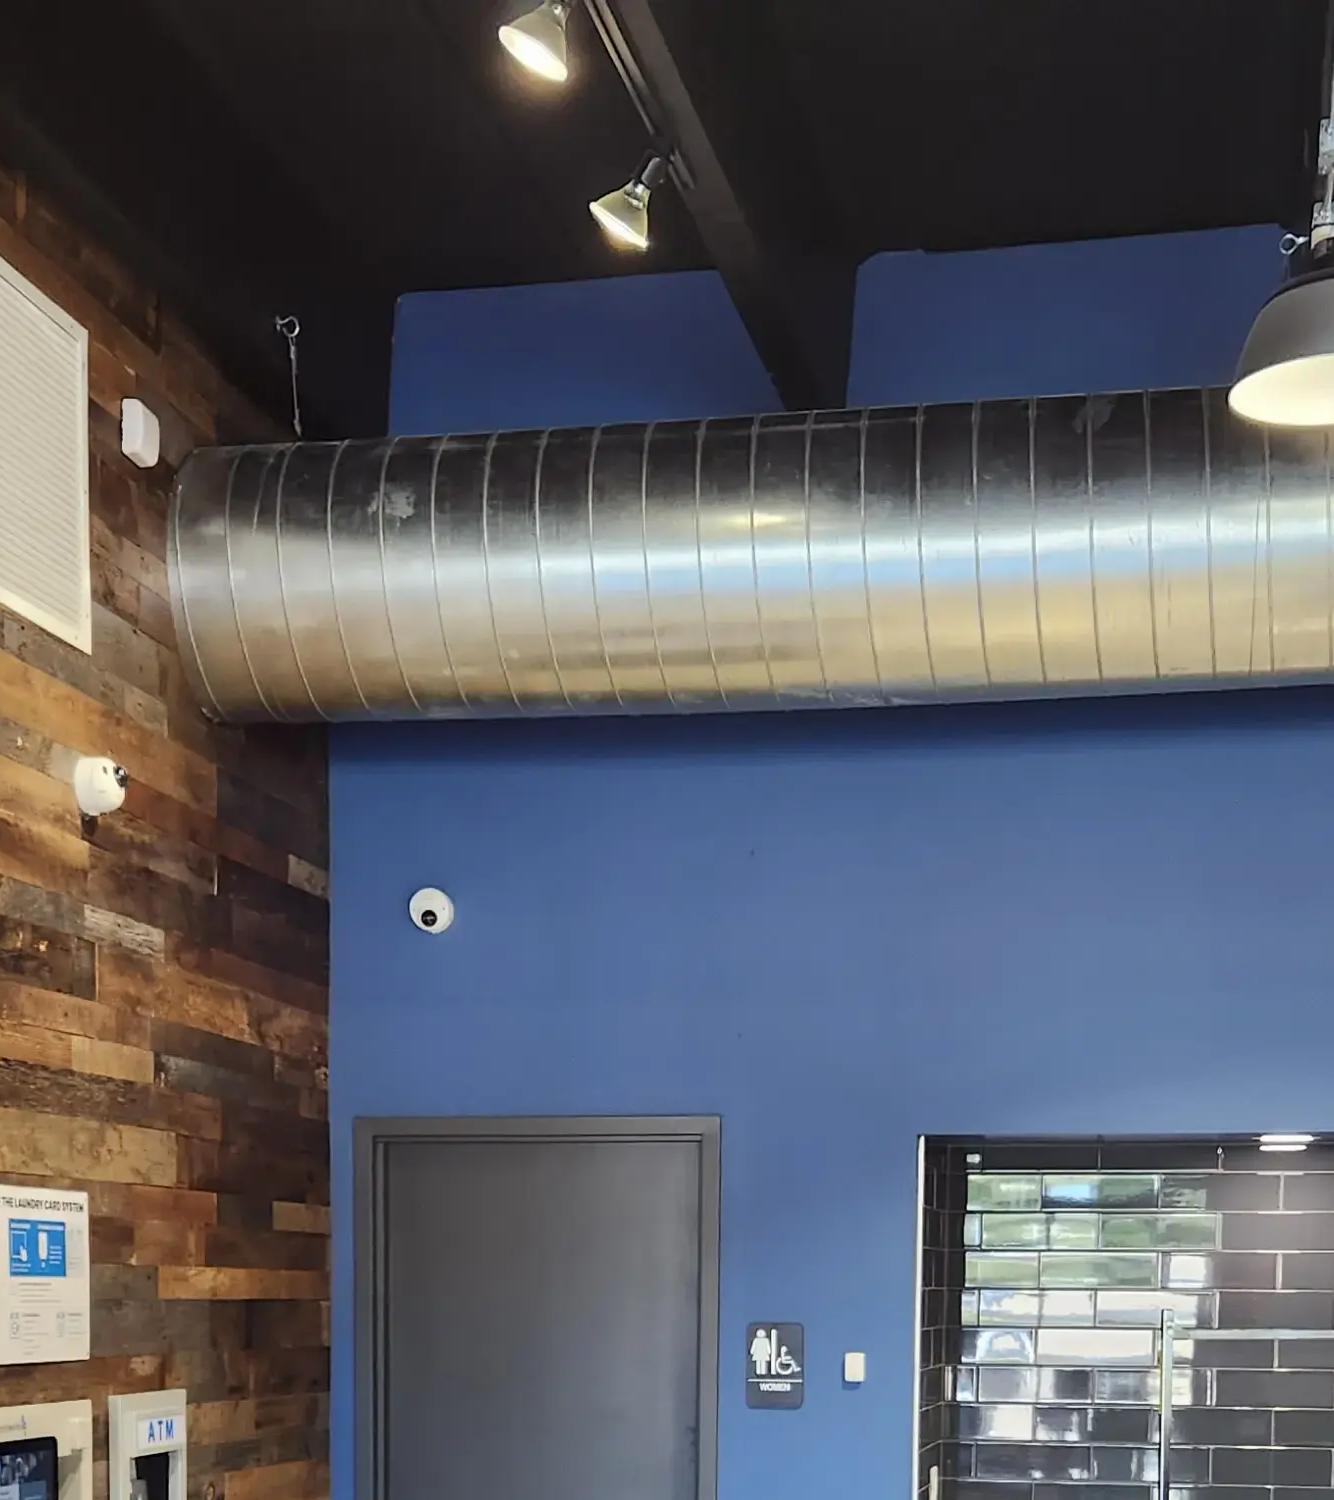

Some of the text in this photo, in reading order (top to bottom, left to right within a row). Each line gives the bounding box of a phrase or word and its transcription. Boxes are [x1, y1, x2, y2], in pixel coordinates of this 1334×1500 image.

[2, 1197, 14, 1208] THE
[14, 1198, 43, 1210] LAUNDRY
[44, 1200, 61, 1211] CARD
[62, 1202, 84, 1212] SYSTEM
[758, 1382, 792, 1392] WOMEN
[147, 1419, 174, 1444] ATM
